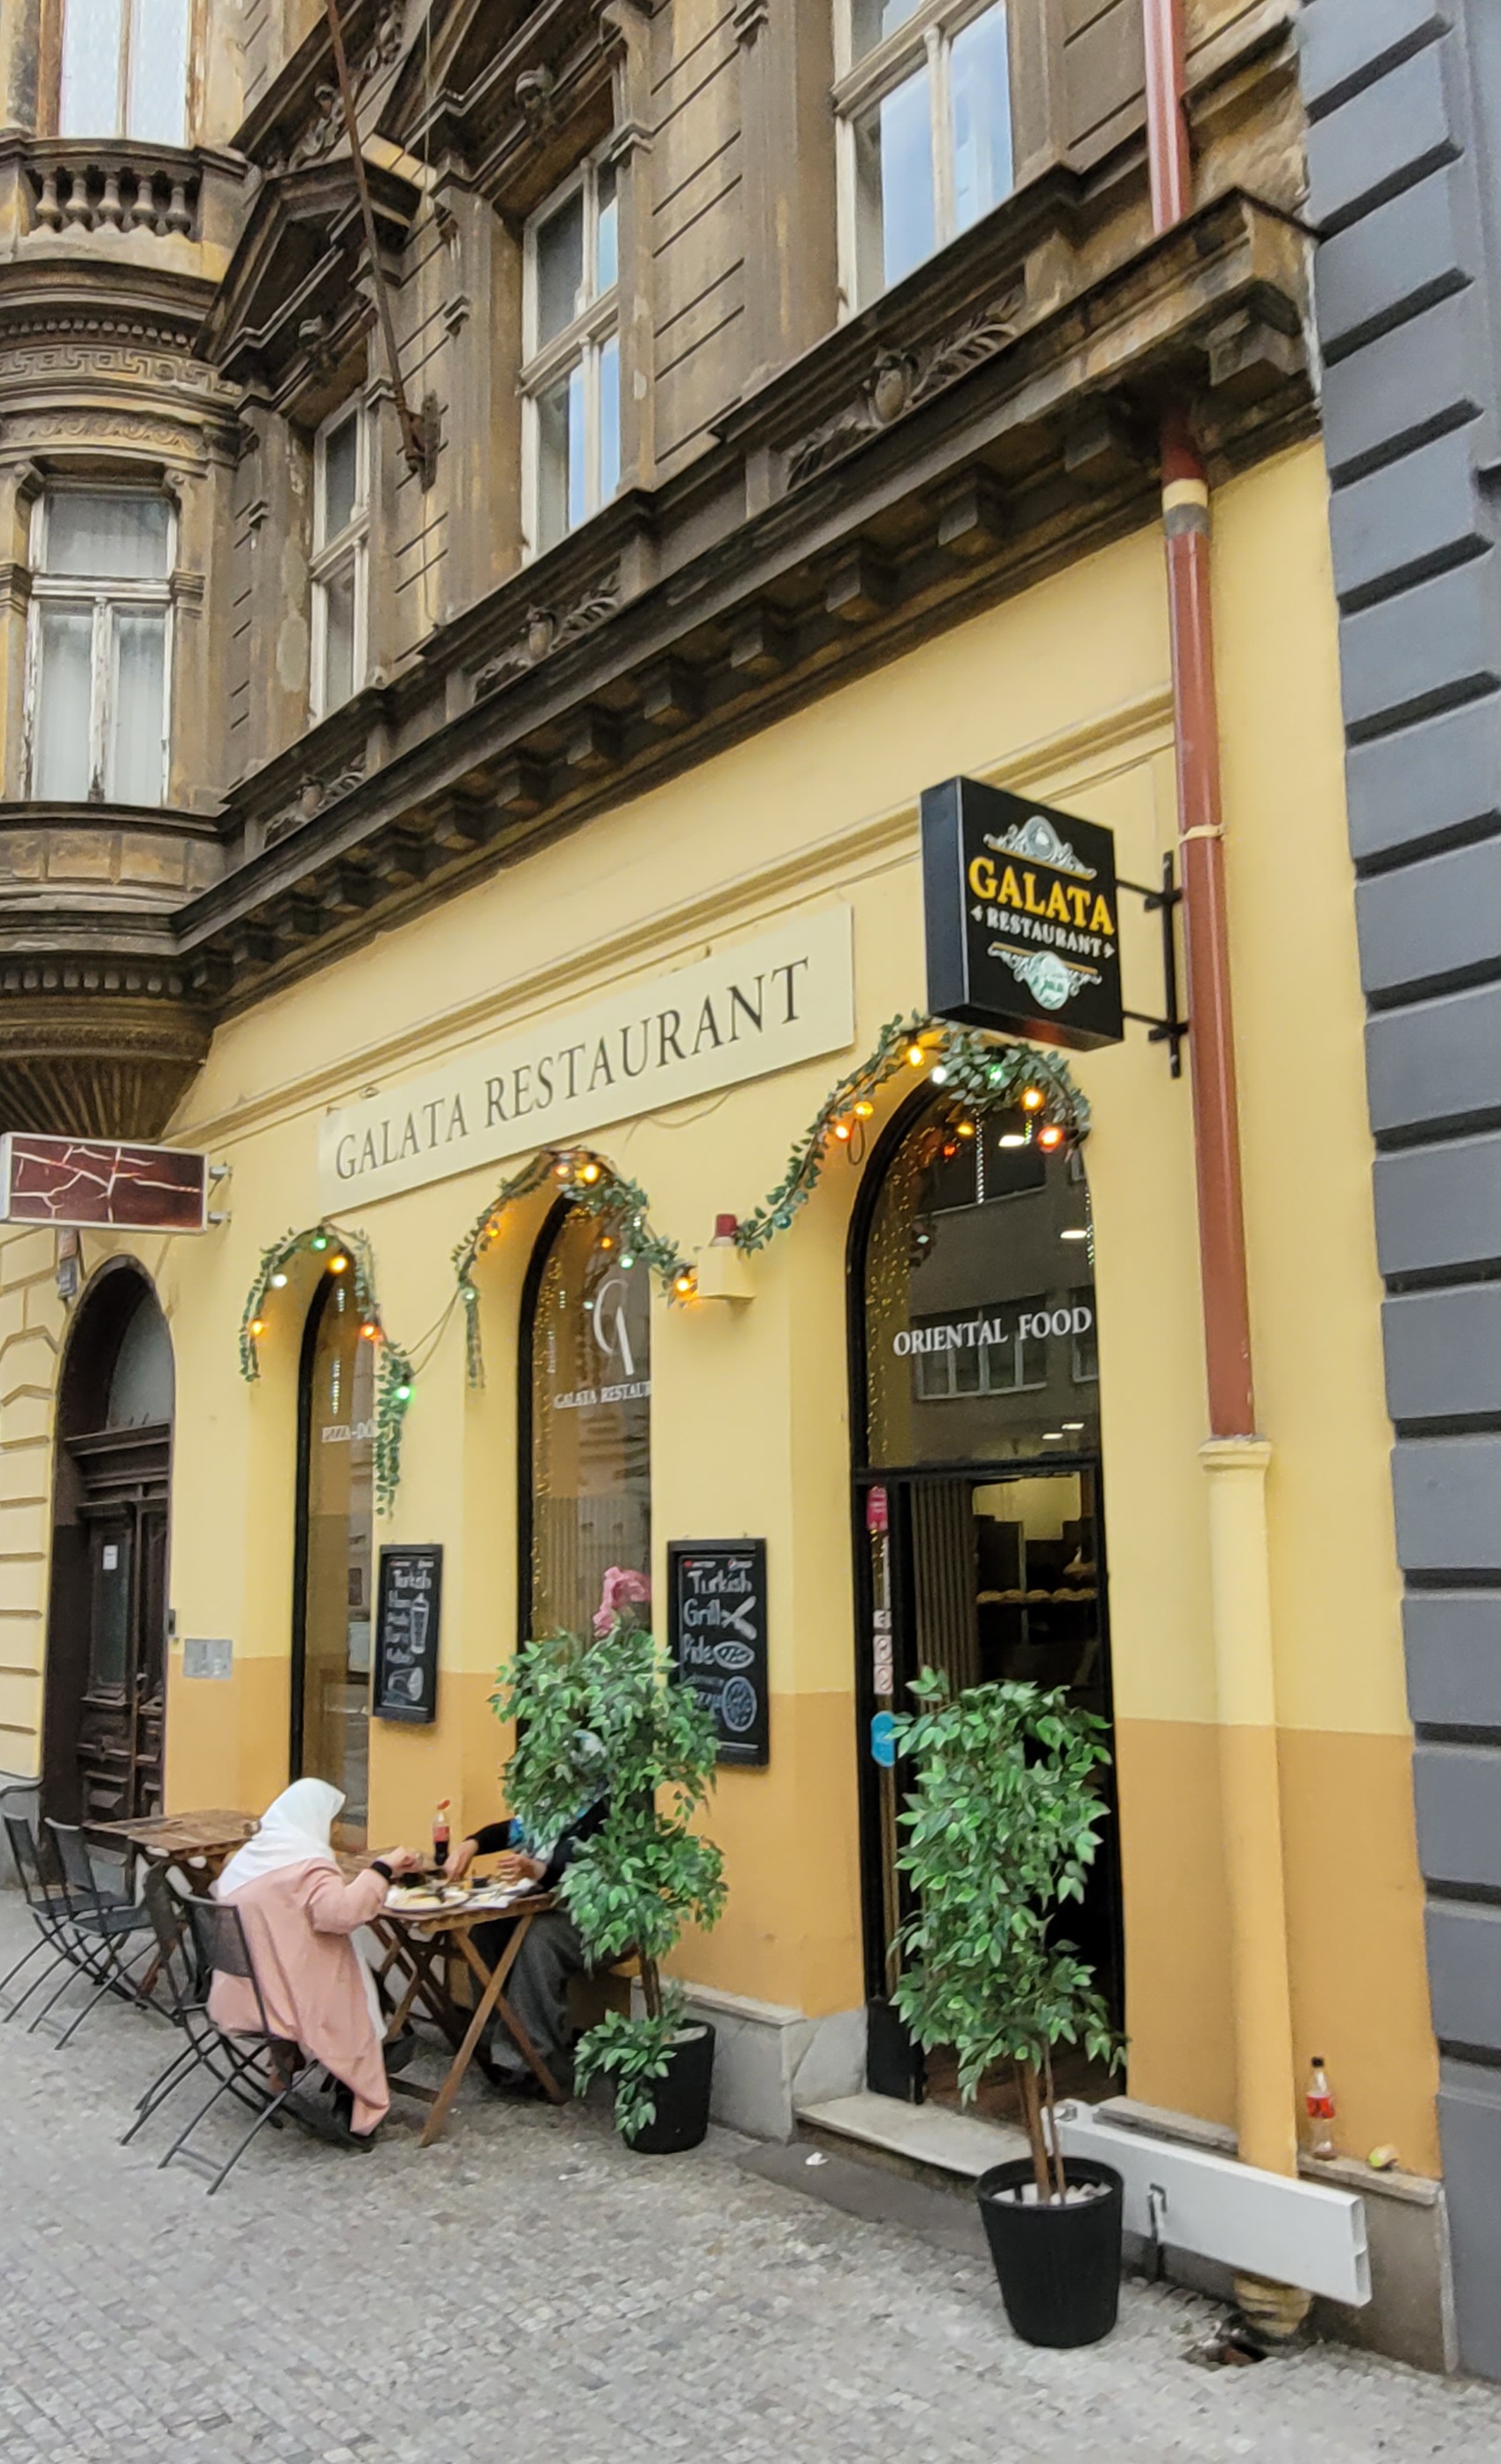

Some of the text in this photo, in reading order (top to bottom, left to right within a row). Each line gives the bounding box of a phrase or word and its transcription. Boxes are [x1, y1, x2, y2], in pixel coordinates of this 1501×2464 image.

[969, 856, 1114, 936] GALATA
[986, 907, 1103, 957] RESTAURANT
[335, 956, 809, 1180] GALATA RESTAURANT
[892, 1306, 1092, 1356] ORIENTAL FOOD
[687, 1570, 753, 1594] Turkish
[683, 1597, 721, 1627] Grill
